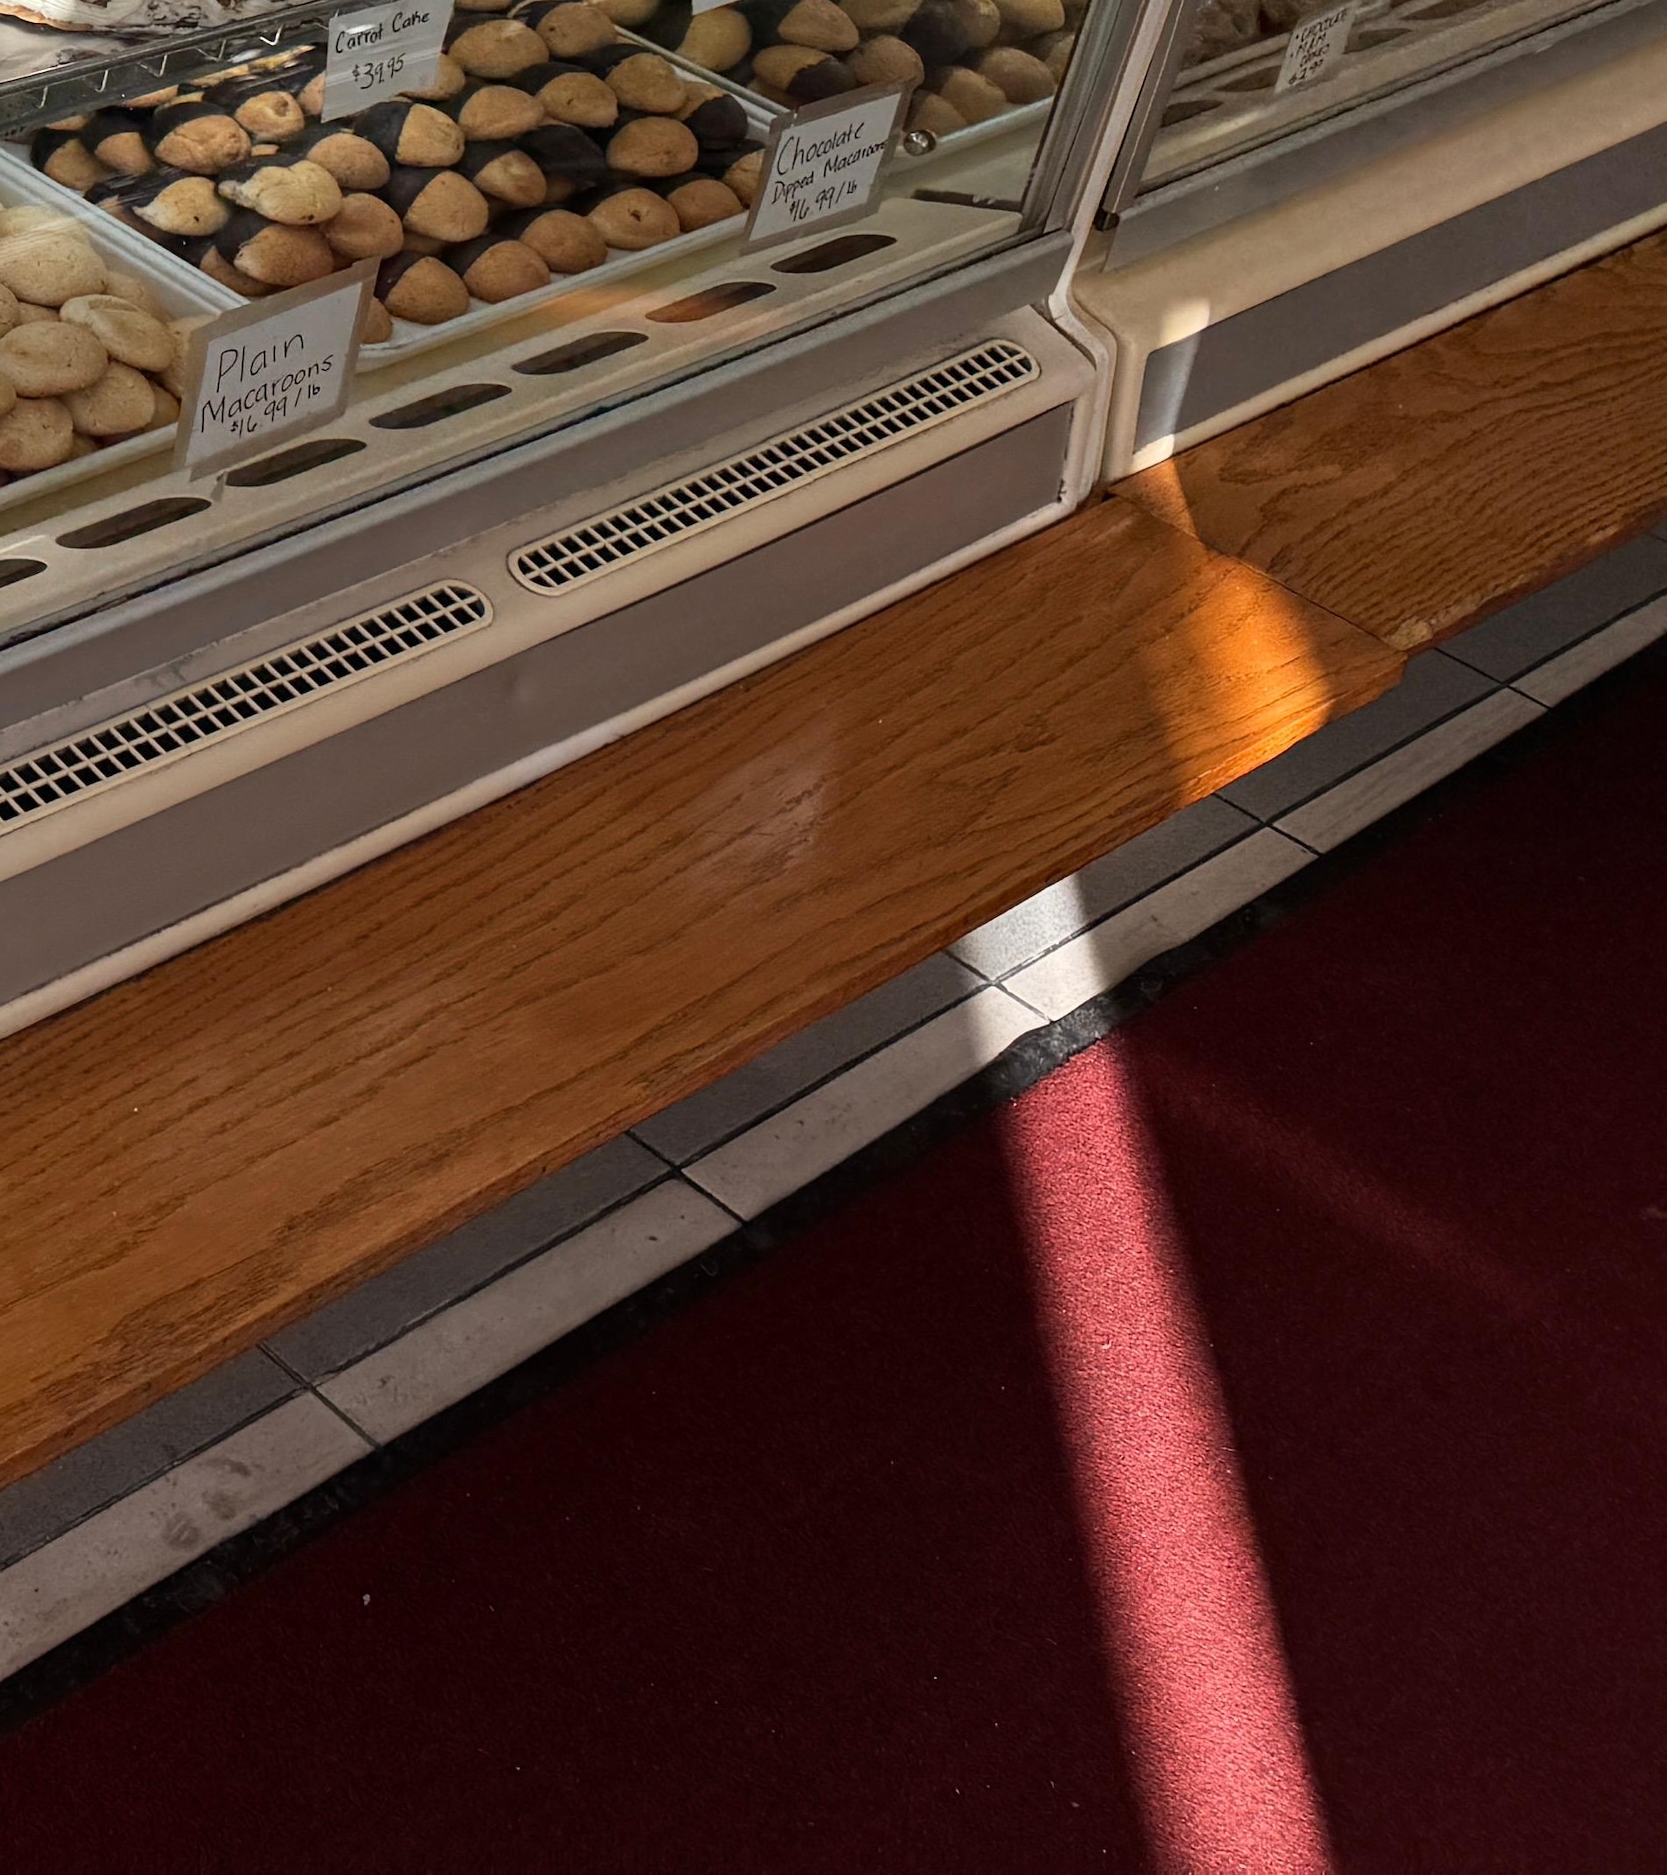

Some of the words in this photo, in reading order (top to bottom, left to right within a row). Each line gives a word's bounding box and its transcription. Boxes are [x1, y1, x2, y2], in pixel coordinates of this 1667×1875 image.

[335, 22, 384, 53] Carrot
[392, 10, 430, 33] Cake
[777, 121, 865, 175] Chocolate
[771, 171, 814, 204] Dipped
[216, 333, 304, 393] Plain
[201, 354, 335, 433] Macaroons
